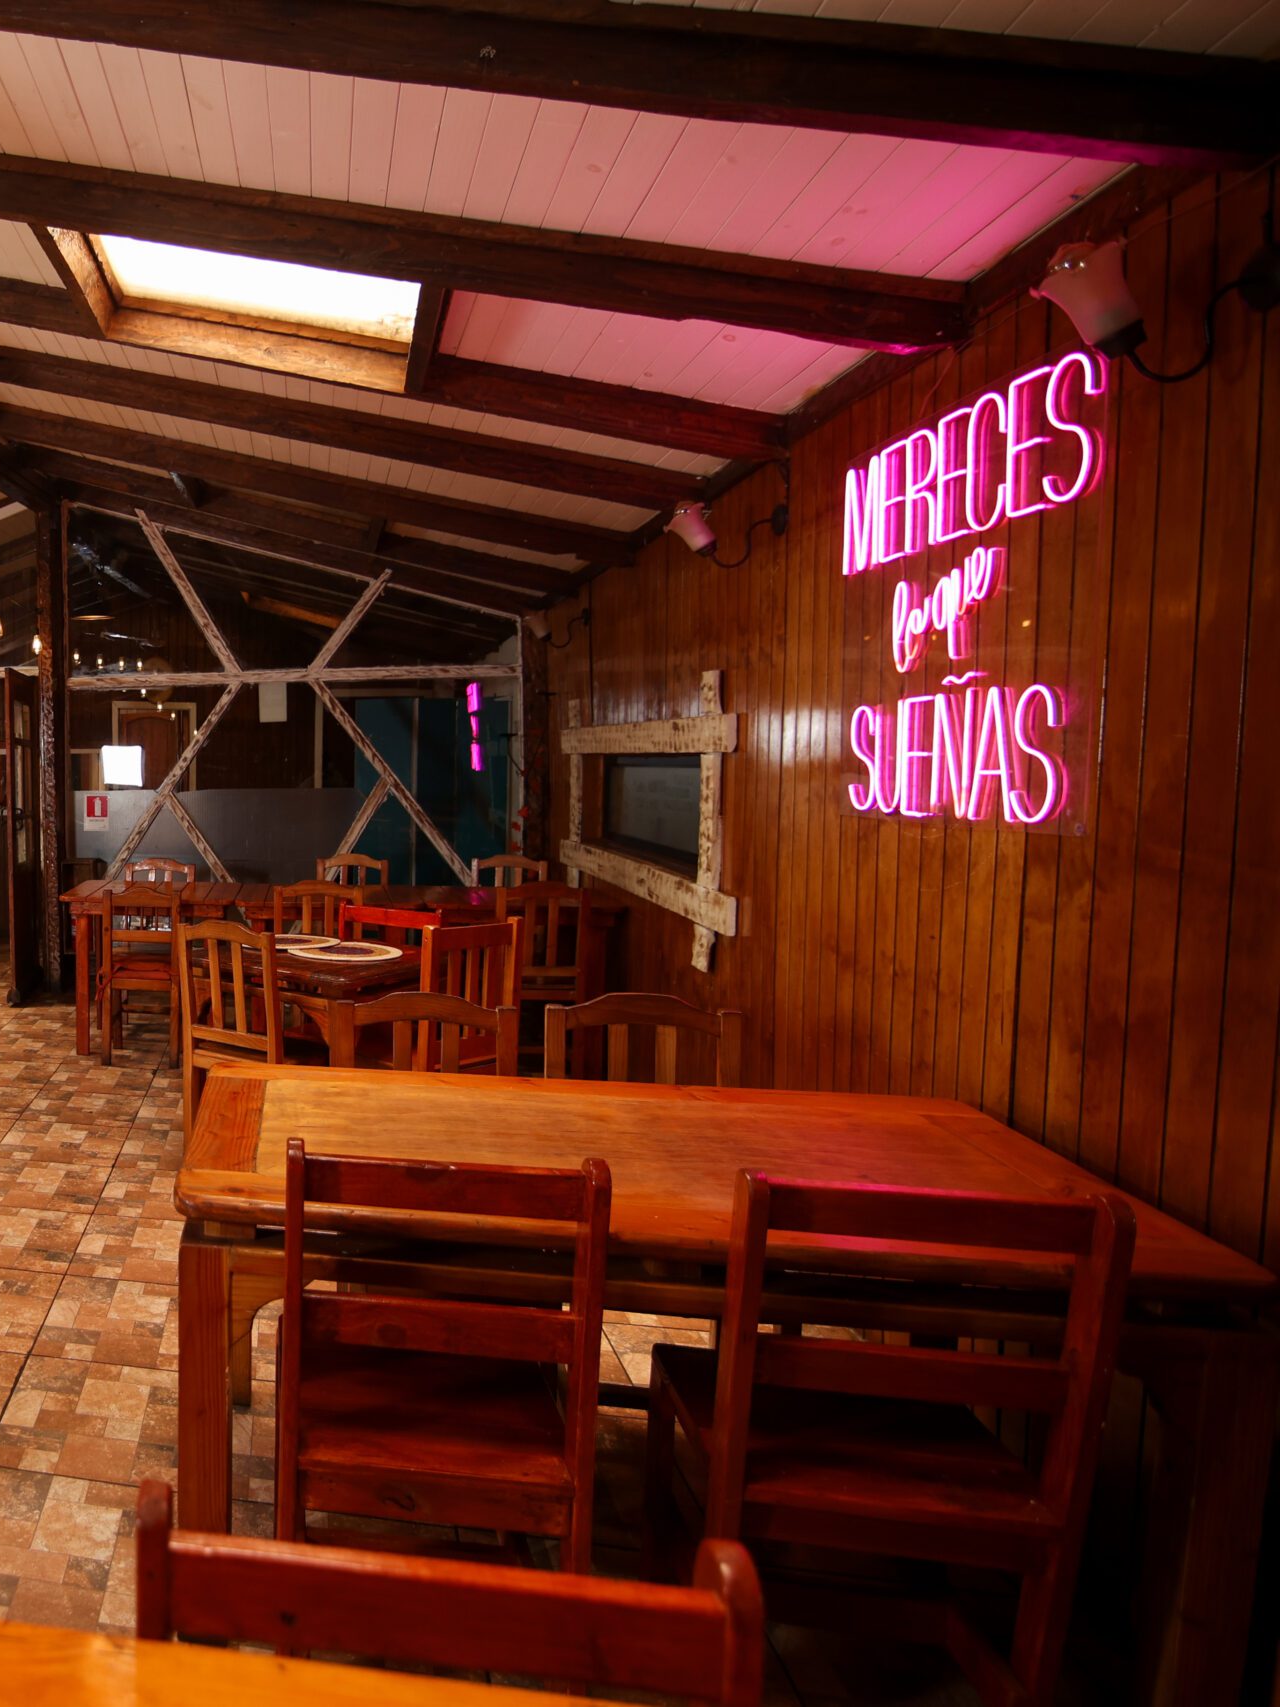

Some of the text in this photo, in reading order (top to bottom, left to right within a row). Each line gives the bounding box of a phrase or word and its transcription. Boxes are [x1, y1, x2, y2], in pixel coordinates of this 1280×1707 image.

[842, 352, 1100, 576] MERECES
[932, 546, 997, 660] que
[848, 671, 1065, 824] SUEÑAS
